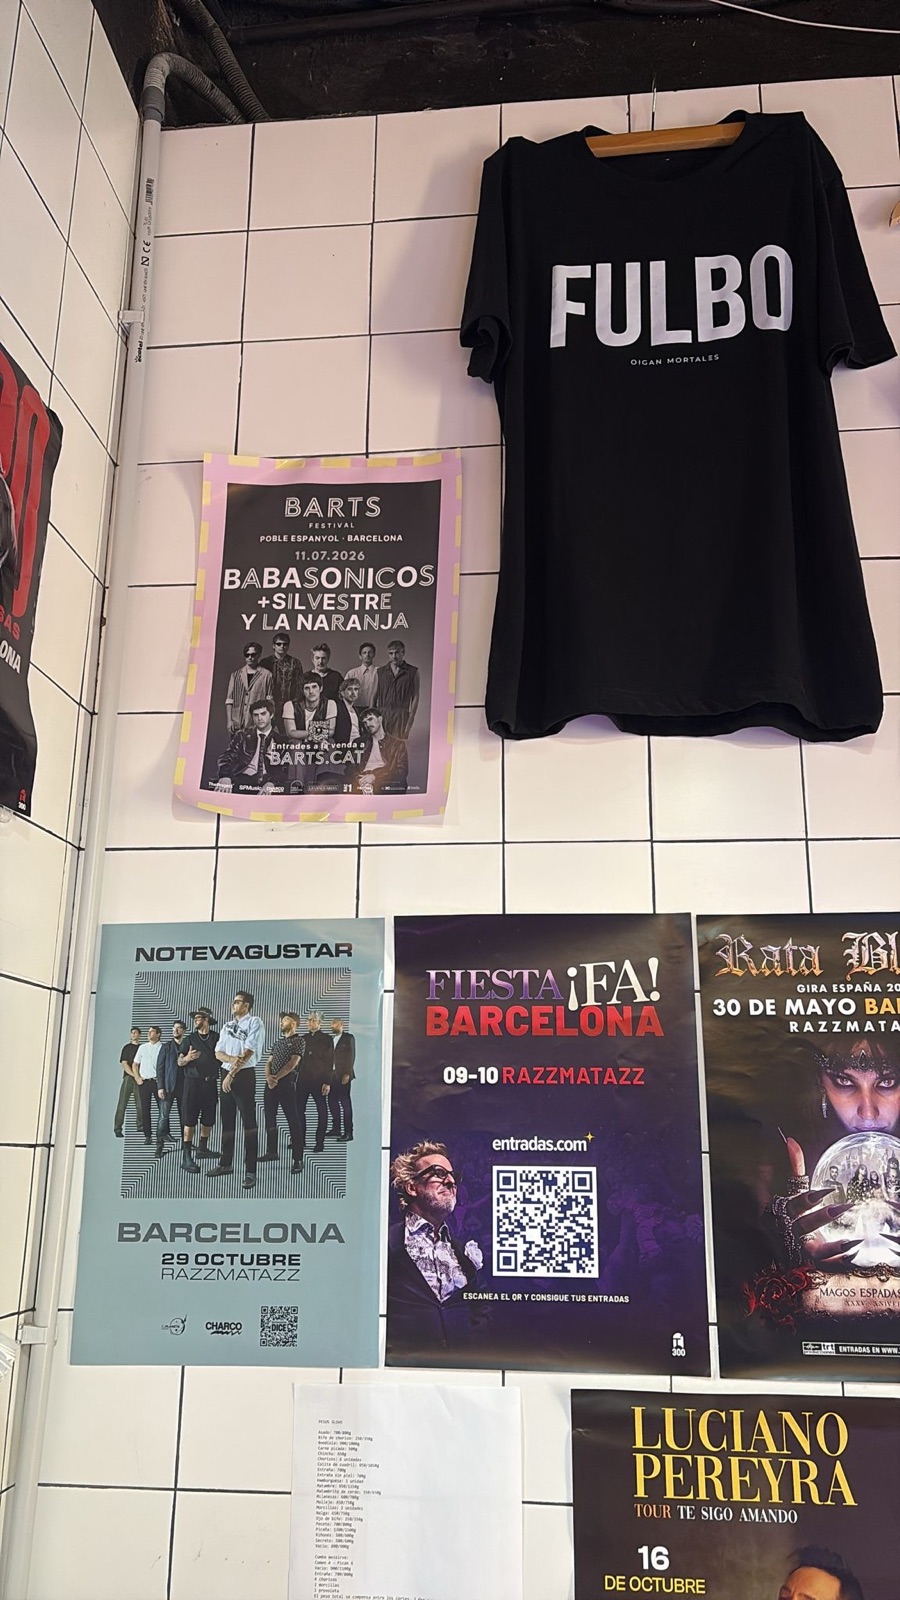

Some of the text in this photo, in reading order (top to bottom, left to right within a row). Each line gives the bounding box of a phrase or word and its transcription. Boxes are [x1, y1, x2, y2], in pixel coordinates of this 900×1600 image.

[550, 244, 793, 348] FULBO
[630, 354, 720, 366] OIGAN MORTALES
[284, 496, 380, 518] BARTS
[260, 534, 402, 543] POBLE ESPANYOL BARCELONA
[295, 550, 365, 561] 11.07.2026
[224, 565, 434, 589] BABASONICOS
[258, 593, 392, 610] +SILVESTRE
[241, 612, 409, 631] Y LA NARANJA
[270, 750, 365, 765] BARTS.CAT
[135, 943, 352, 962] NOTEVAGUSTAR
[715, 934, 824, 977] Rata
[426, 957, 661, 1011] FIESTA ¡FA!
[797, 984, 827, 993] GIRA
[833, 981, 882, 992] ESPAÑA
[712, 998, 900, 1016] 30 DE MAYO BA
[426, 1006, 664, 1037] BARCELONA
[789, 1021, 900, 1032] RAZZMATA
[443, 1067, 645, 1085] 09-10 RAZZMATAZZ
[492, 1136, 587, 1152] entradas.com
[117, 1222, 345, 1243] BARCELONA
[162, 1253, 301, 1266] 29 OCTUBRE
[161, 1268, 300, 1281] RAZZMATAZZ
[820, 1288, 856, 1297] MAGOS
[205, 1322, 242, 1330] CHARCO
[271, 1324, 286, 1332] DICE
[672, 1348, 686, 1356] 300
[631, 1406, 849, 1457] LUCIANO
[633, 1453, 858, 1506] PEREYRA
[634, 1503, 798, 1524] TOUR TE SIGO AMANDO
[637, 1546, 670, 1571] 16
[604, 1575, 706, 1594] DE OCTUBRE
